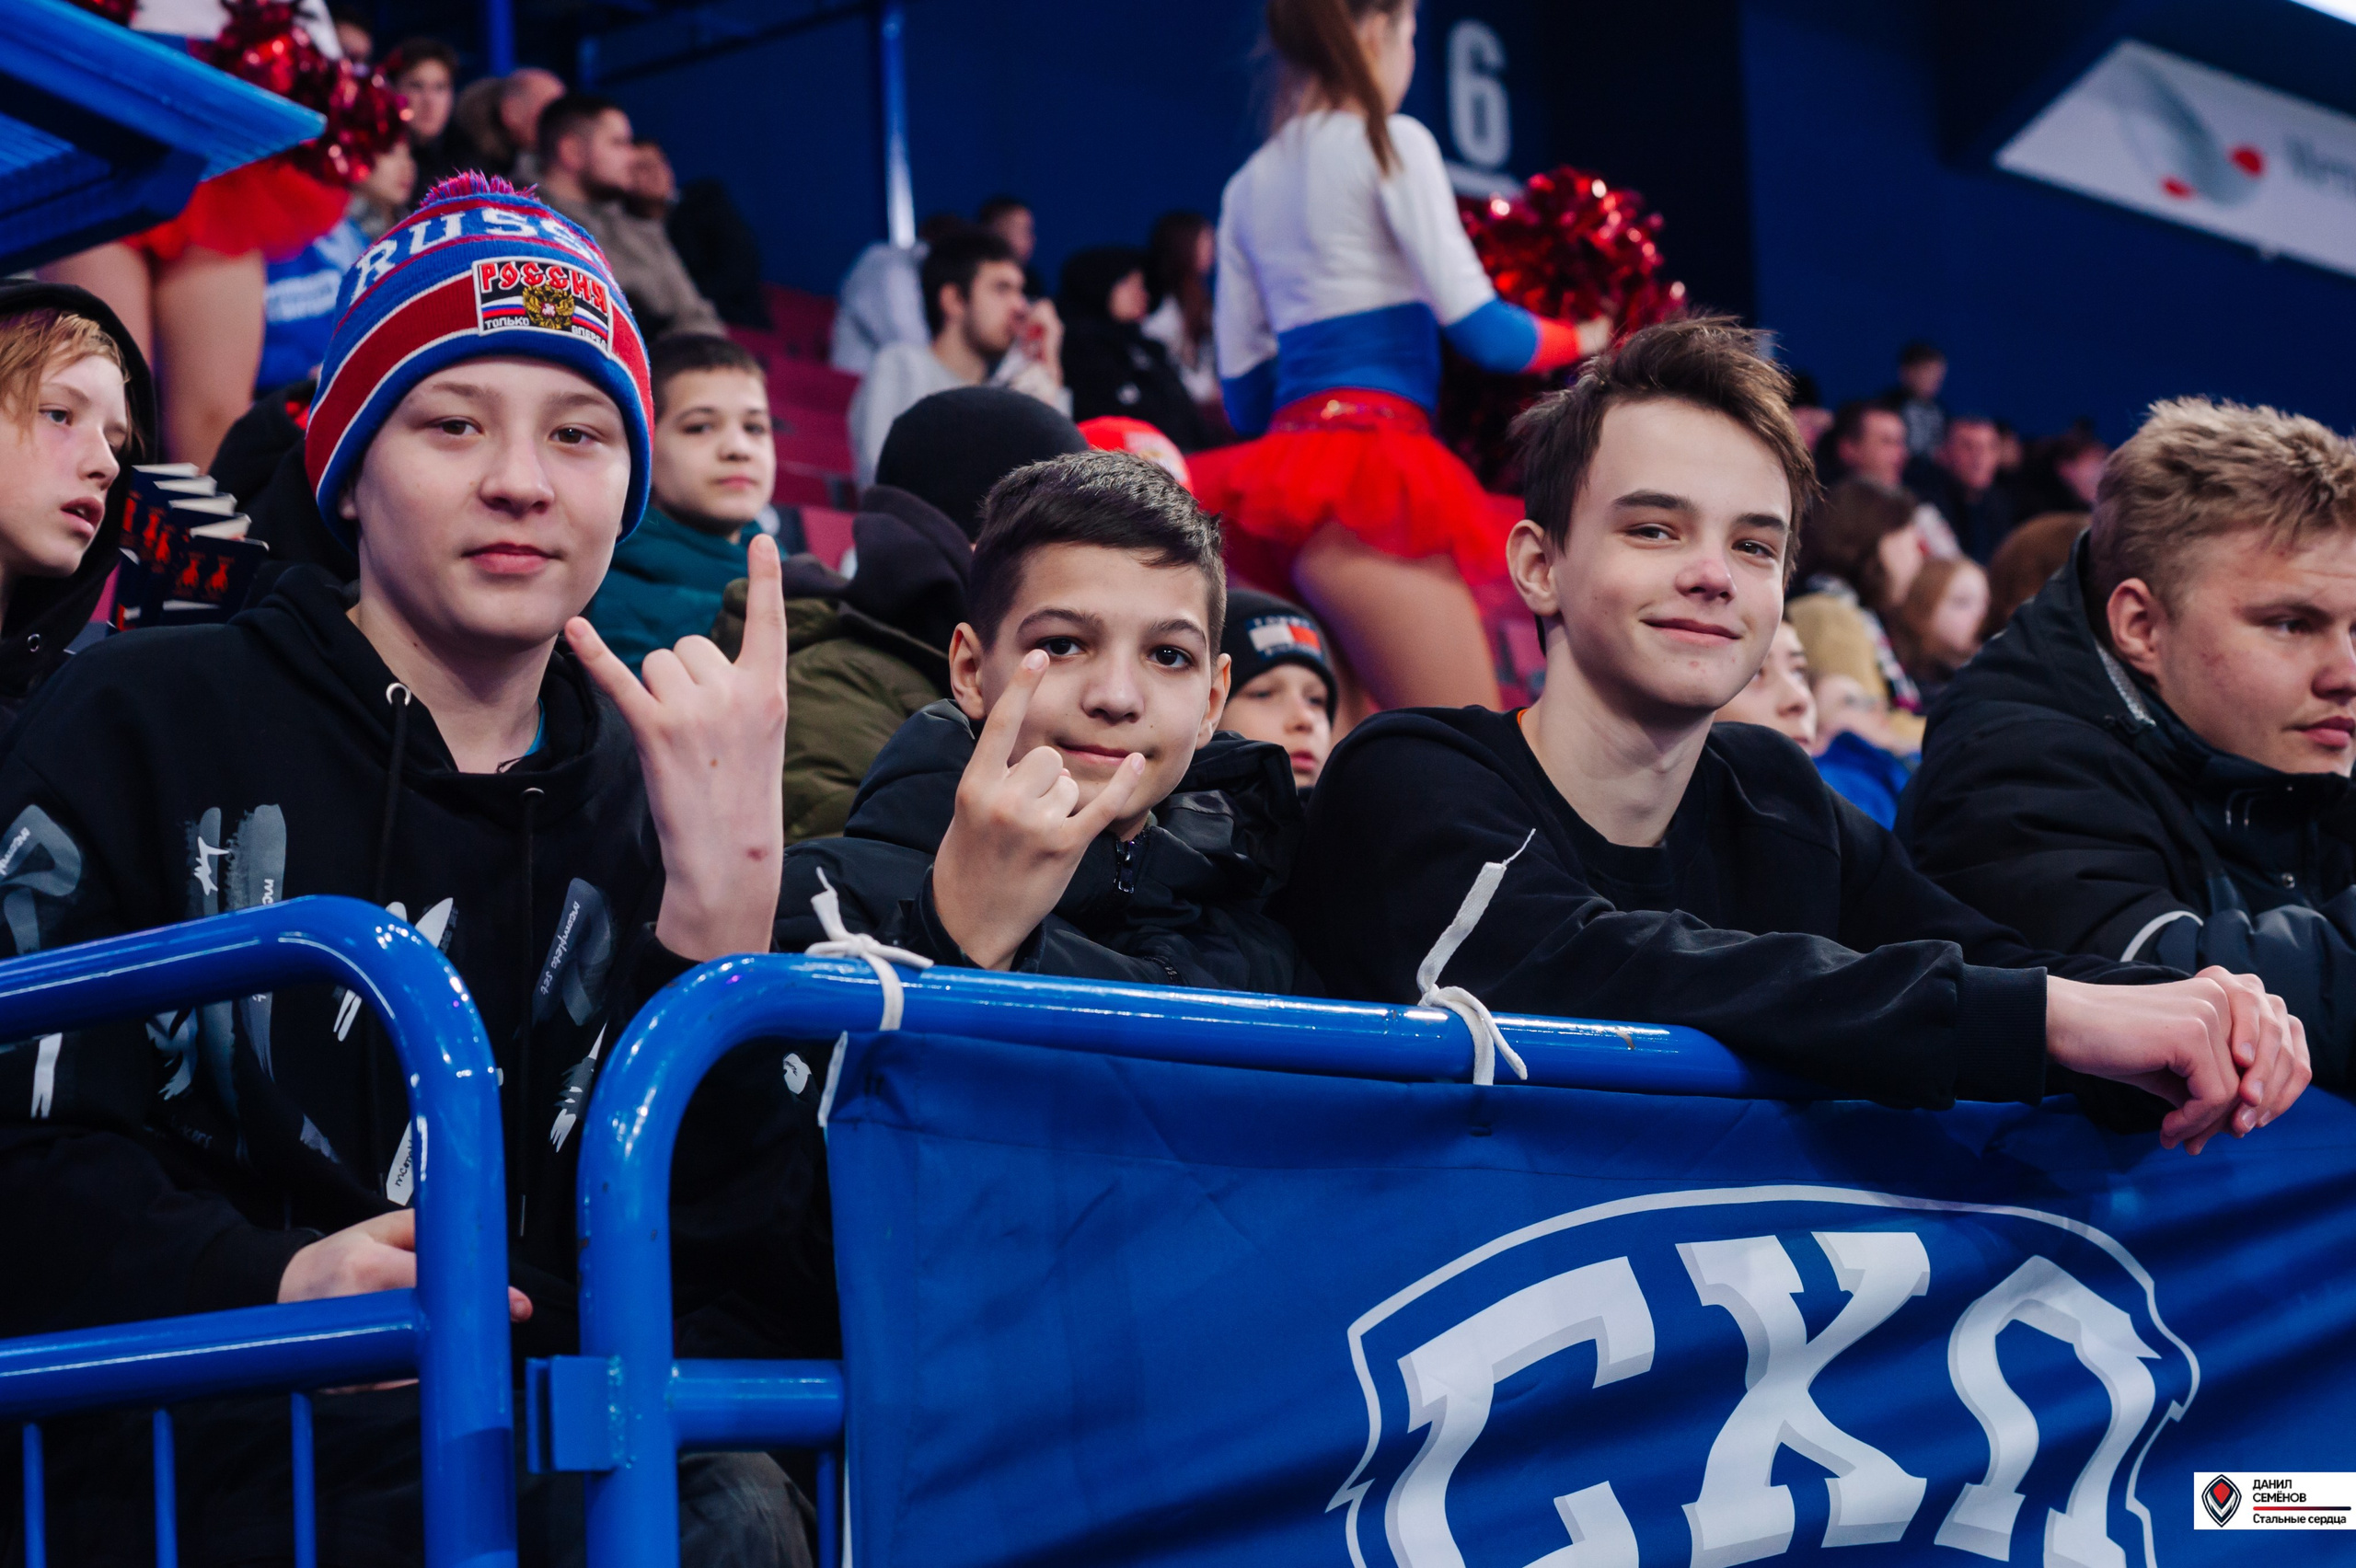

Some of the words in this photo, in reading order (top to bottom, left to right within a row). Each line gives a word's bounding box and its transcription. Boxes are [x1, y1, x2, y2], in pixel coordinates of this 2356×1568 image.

[1446, 20, 1510, 167] 6
[479, 261, 608, 314] РОССИЯ
[484, 317, 530, 329] ТОЛЬКО
[540, 971, 553, 995] set
